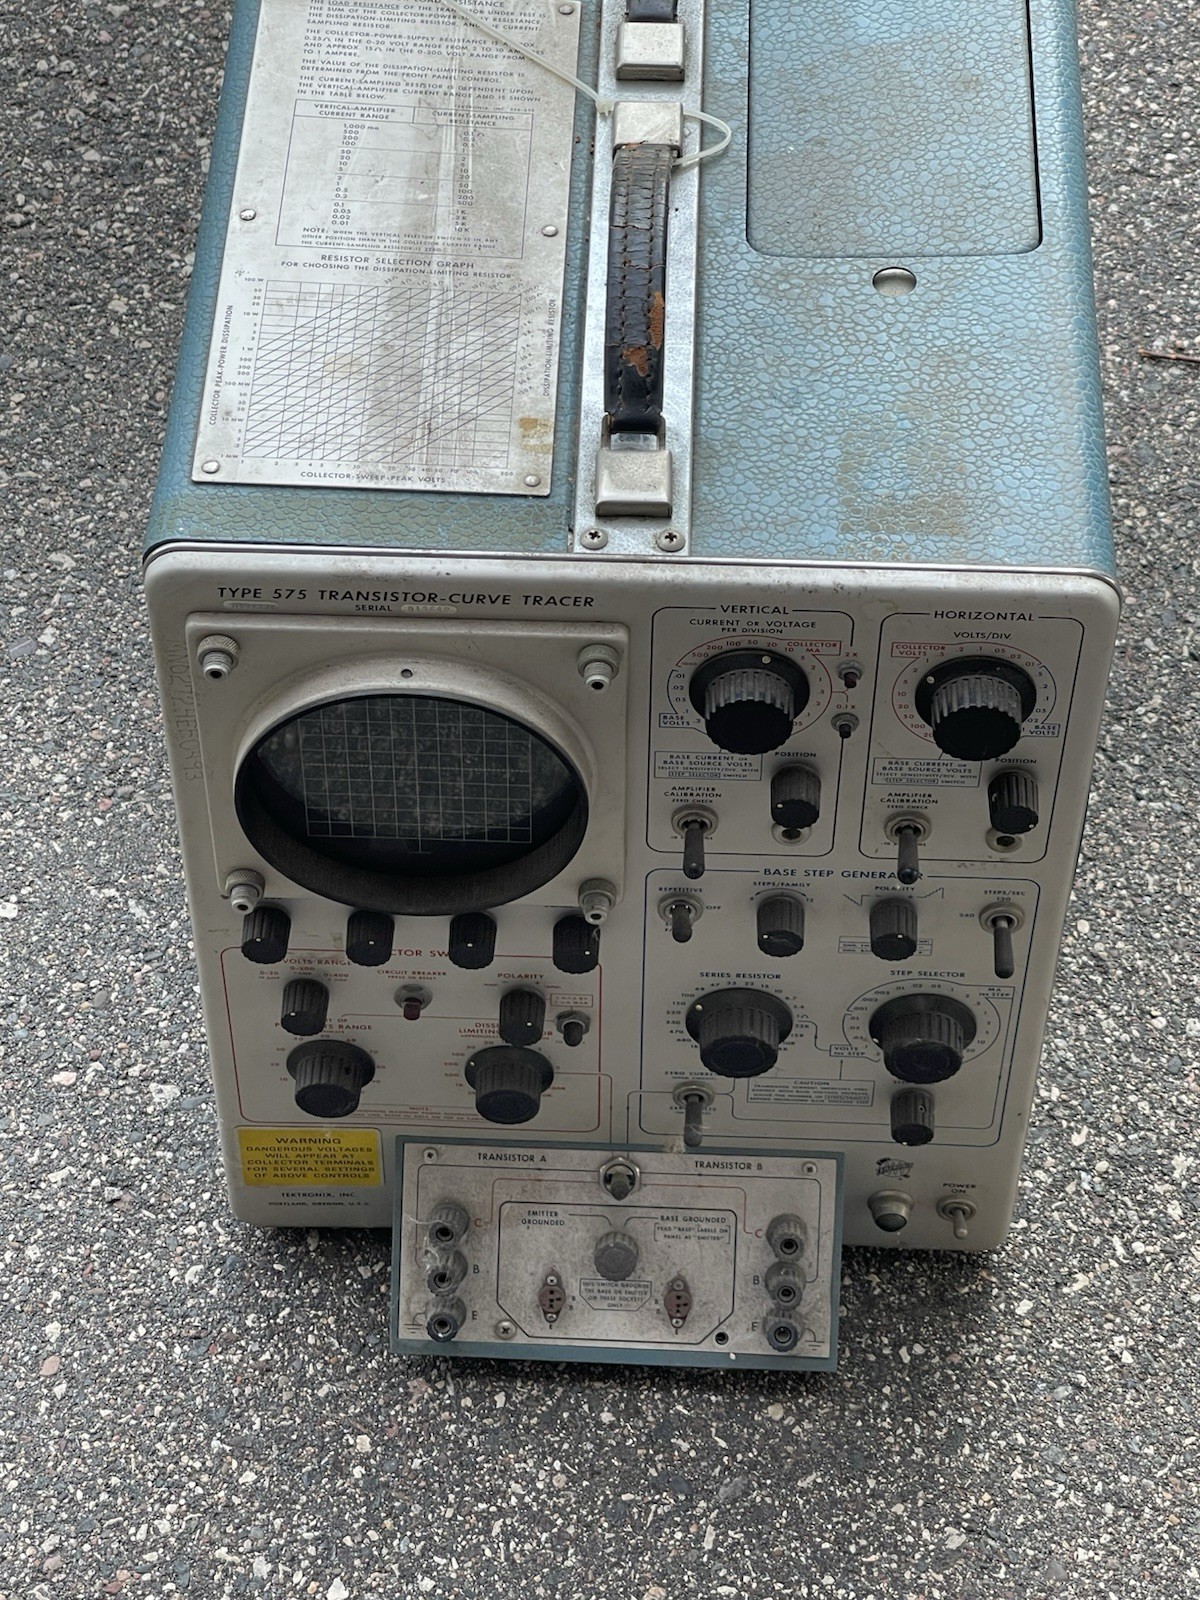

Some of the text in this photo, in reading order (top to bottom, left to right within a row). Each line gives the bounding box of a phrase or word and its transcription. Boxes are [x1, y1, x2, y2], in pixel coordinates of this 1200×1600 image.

[354, 1, 400, 9] RESISTANCE
[325, 29, 436, 41] COLLECTOR-POWER-SUPPLY
[439, 37, 487, 45] RESISTANCE
[382, 63, 473, 75] DISSIPATION-LIMITING
[314, 103, 396, 113] VERTICAL-AMPLIFIER
[321, 254, 474, 269] RESISTOR SELECTION GRAPH
[303, 262, 351, 270] CHOOSING
[373, 266, 469, 277] DISSIPATION-LIMITING
[548, 299, 556, 326] RESISTOR
[209, 305, 234, 425] COLLECTOR PEAK-POWER DISSIPATION
[418, 476, 446, 484] VOLTS
[218, 587, 595, 608] TYPE 575 TRANSISTOR-CURVE TRACER
[355, 604, 392, 612] SERIAL
[720, 604, 789, 615] VERTICAL
[934, 610, 1035, 621] HORIZONTAL
[766, 621, 816, 629] VOLTAGE
[953, 631, 1013, 640] VOLTS/DIV.
[763, 868, 924, 880] BASE STEP GENERAR
[276, 1137, 342, 1145] WARNING
[477, 1152, 547, 1163] TRANSISTOR A
[694, 1160, 763, 1171] TRANSISTOR B
[527, 1210, 559, 1218] EMITTER
[474, 1219, 482, 1228] C
[682, 1216, 727, 1224] GROUNDED
[755, 1229, 763, 1238] C
[473, 1264, 480, 1274] B
[753, 1275, 760, 1285] B
[472, 1310, 478, 1320] E
[751, 1322, 758, 1332] E
